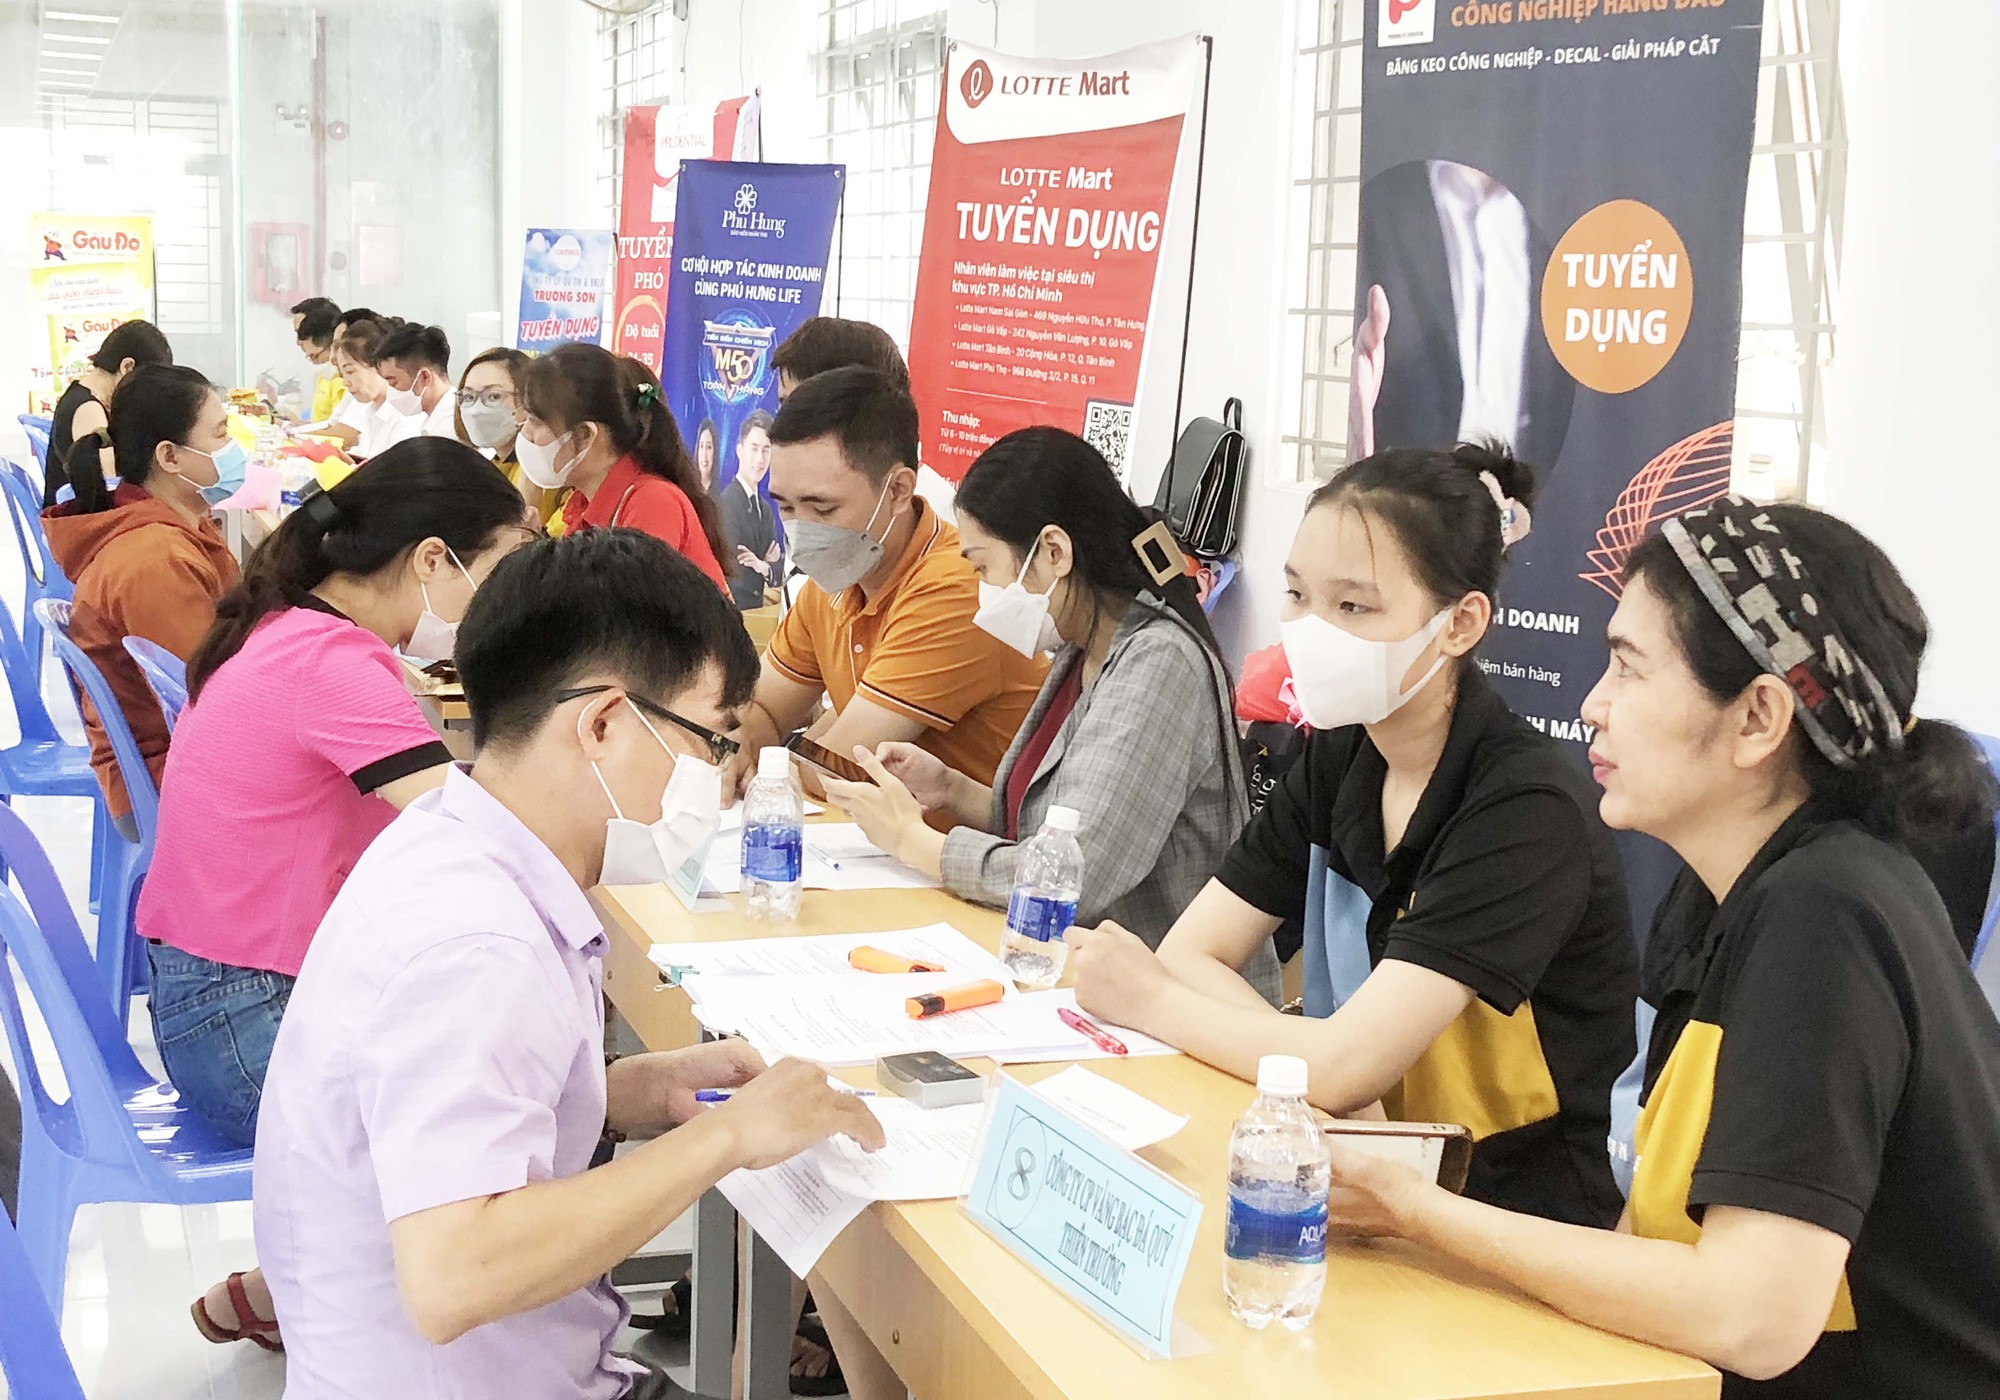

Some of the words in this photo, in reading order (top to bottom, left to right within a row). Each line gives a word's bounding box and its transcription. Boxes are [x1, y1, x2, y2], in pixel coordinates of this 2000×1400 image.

[1420, 57, 1446, 73] KEO
[1449, 51, 1490, 72] CÔNG
[1493, 46, 1543, 70] NGHIỆP
[1554, 46, 1602, 65] DECAL
[1611, 38, 1641, 61] GIẢI
[1643, 36, 1686, 59] PHÁP
[1688, 33, 1721, 56] CẮT
[1001, 75, 1073, 96] LOTTE
[1078, 70, 1131, 97] Mart
[1000, 167, 1062, 188] LOTTE
[1066, 166, 1113, 191] Mart
[956, 188, 1060, 246] TUYỂN
[1064, 208, 1160, 260] DỤNG
[681, 257, 695, 272] CƠ
[695, 255, 709, 276] HỘI
[710, 259, 733, 277] HỢP
[736, 258, 756, 277] TÁC
[757, 263, 784, 280] KINH
[785, 265, 822, 282] DOANH
[954, 260, 976, 275] Nhân
[977, 262, 996, 277] viên
[998, 264, 1016, 278] làm
[1018, 265, 1039, 283] việc
[1041, 268, 1056, 285] tại
[1057, 269, 1078, 284] siêu
[1080, 271, 1095, 288] thị
[1562, 239, 1678, 289] TUYỂN
[634, 266, 664, 289] PHÓ
[694, 278, 719, 296] CÙNG
[720, 281, 744, 299] PHÚ
[745, 284, 776, 301] HƯNG
[778, 288, 802, 304] LIFE
[952, 279, 969, 294] khu
[970, 283, 986, 297] vực
[987, 283, 1000, 296] TP.
[1002, 283, 1016, 298] Hồ
[1017, 285, 1034, 300] Chí
[1035, 287, 1063, 303] Minh
[625, 324, 639, 340] Độ
[641, 323, 659, 338] tuổi
[1565, 308, 1667, 353] DỤNG
[940, 427, 950, 437] Từ
[942, 410, 959, 424] Thu
[959, 413, 981, 429] nhập:
[1508, 608, 1580, 635] DOANH
[1503, 661, 1526, 679] bán
[1528, 665, 1561, 687] hàng
[1550, 718, 1596, 743] MÁY
[1007, 1147, 1036, 1202] 8
